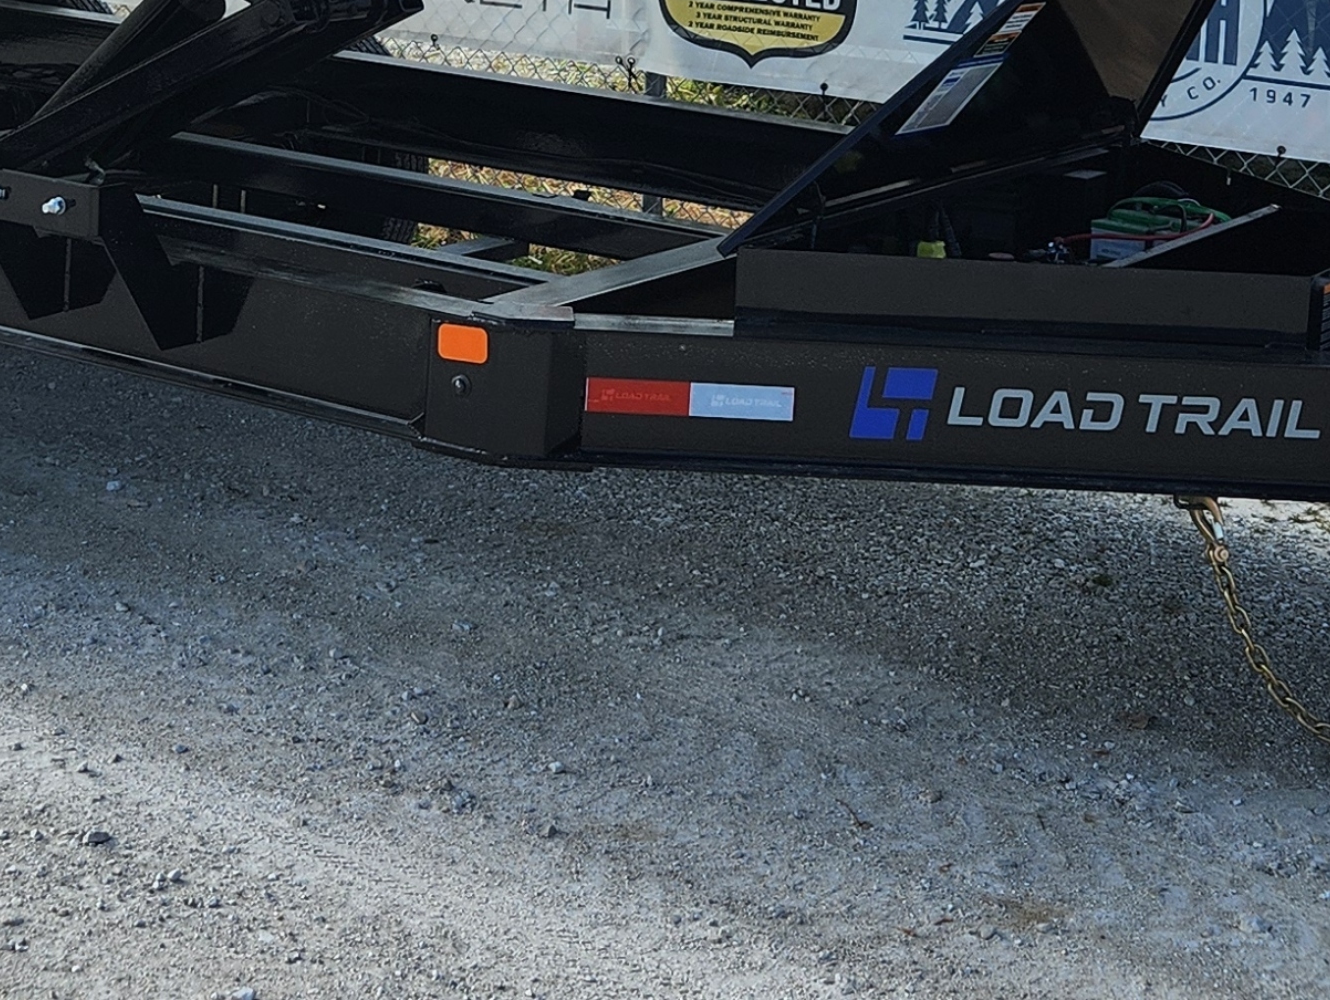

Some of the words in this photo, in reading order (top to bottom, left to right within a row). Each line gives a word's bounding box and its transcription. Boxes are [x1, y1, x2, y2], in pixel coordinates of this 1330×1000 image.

[695, 1, 715, 10] YEAR
[716, 4, 781, 17] COMPREHENSIVE
[782, 11, 820, 22] WARRANTY
[702, 12, 722, 20] YEAR
[723, 14, 772, 26] STRUCTURAL
[773, 20, 813, 31] WARRANTY
[694, 21, 715, 30] YEAR
[716, 24, 755, 35] ROADSIDE
[756, 28, 819, 41] REIMBURSEMENT
[1248, 86, 1312, 109] 1947
[946, 386, 1125, 431] LOAD
[1137, 393, 1322, 439] TRAIL
